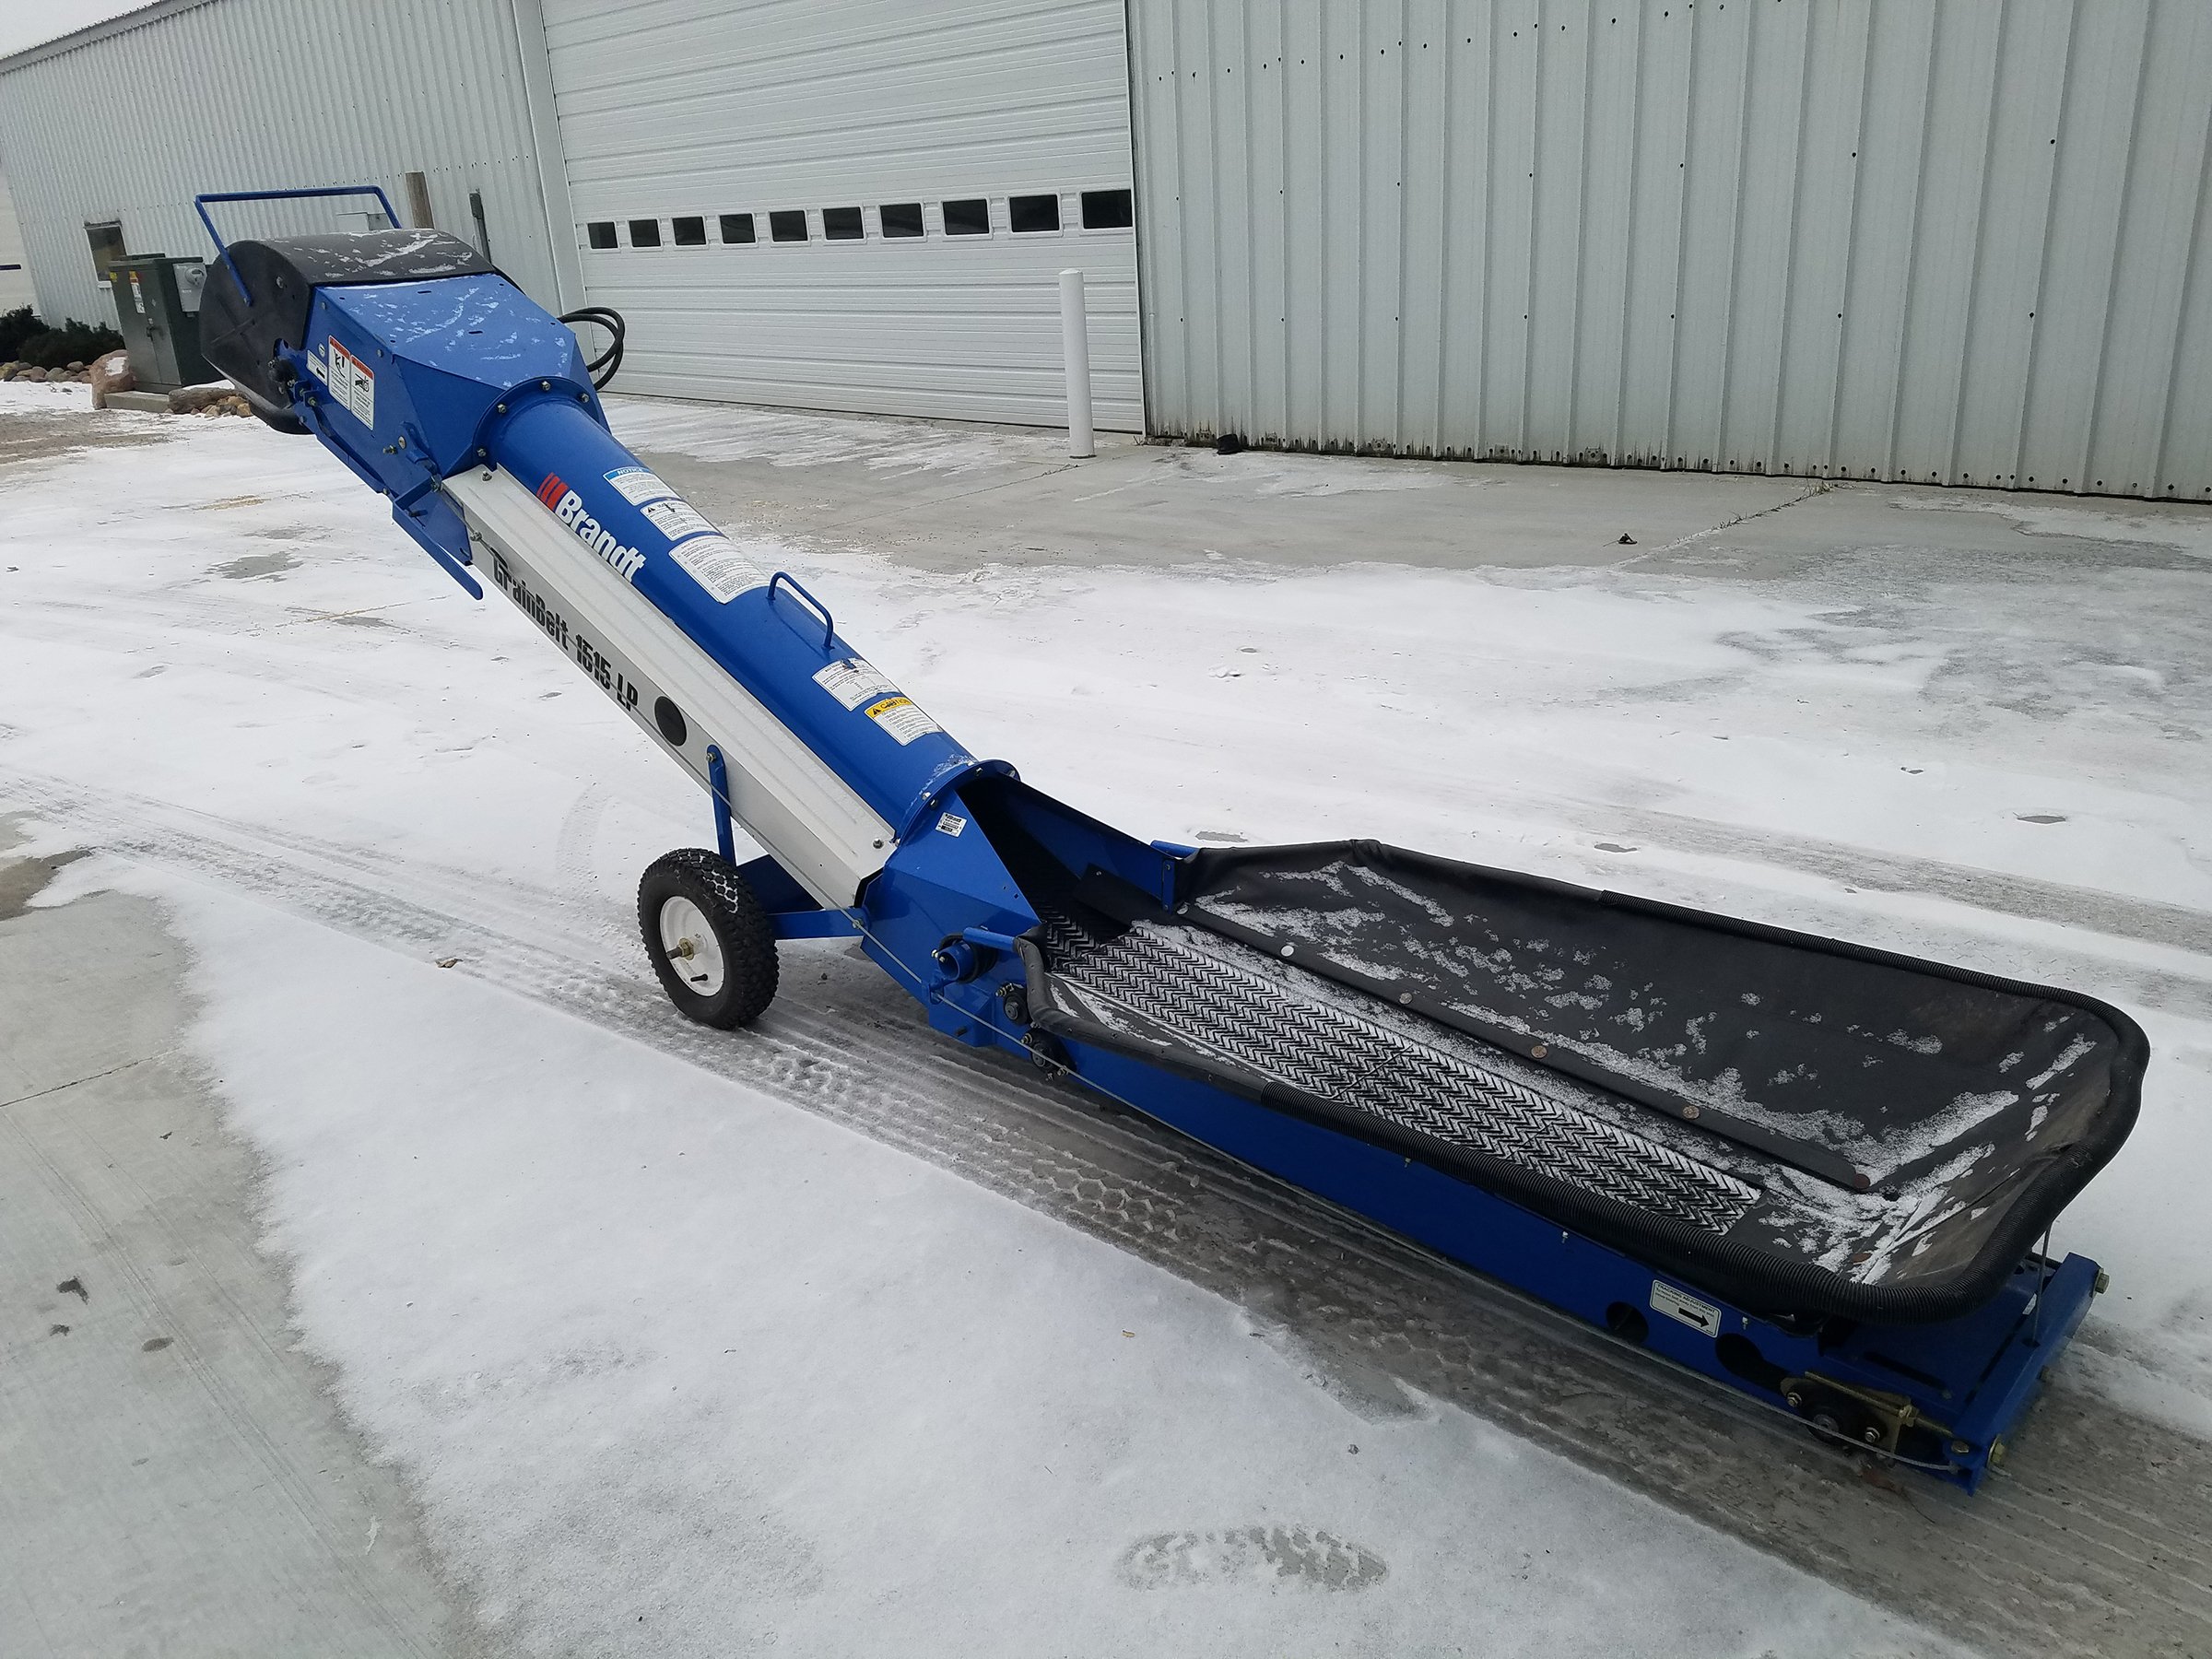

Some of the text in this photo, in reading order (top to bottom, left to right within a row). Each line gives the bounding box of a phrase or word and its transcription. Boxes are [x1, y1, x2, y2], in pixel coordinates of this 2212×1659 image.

[554, 489, 646, 583] Brandt
[490, 547, 639, 712] GrainBelt 1515 LP
[1658, 1284, 1715, 1313] TRACKING ADJUSTMENT
